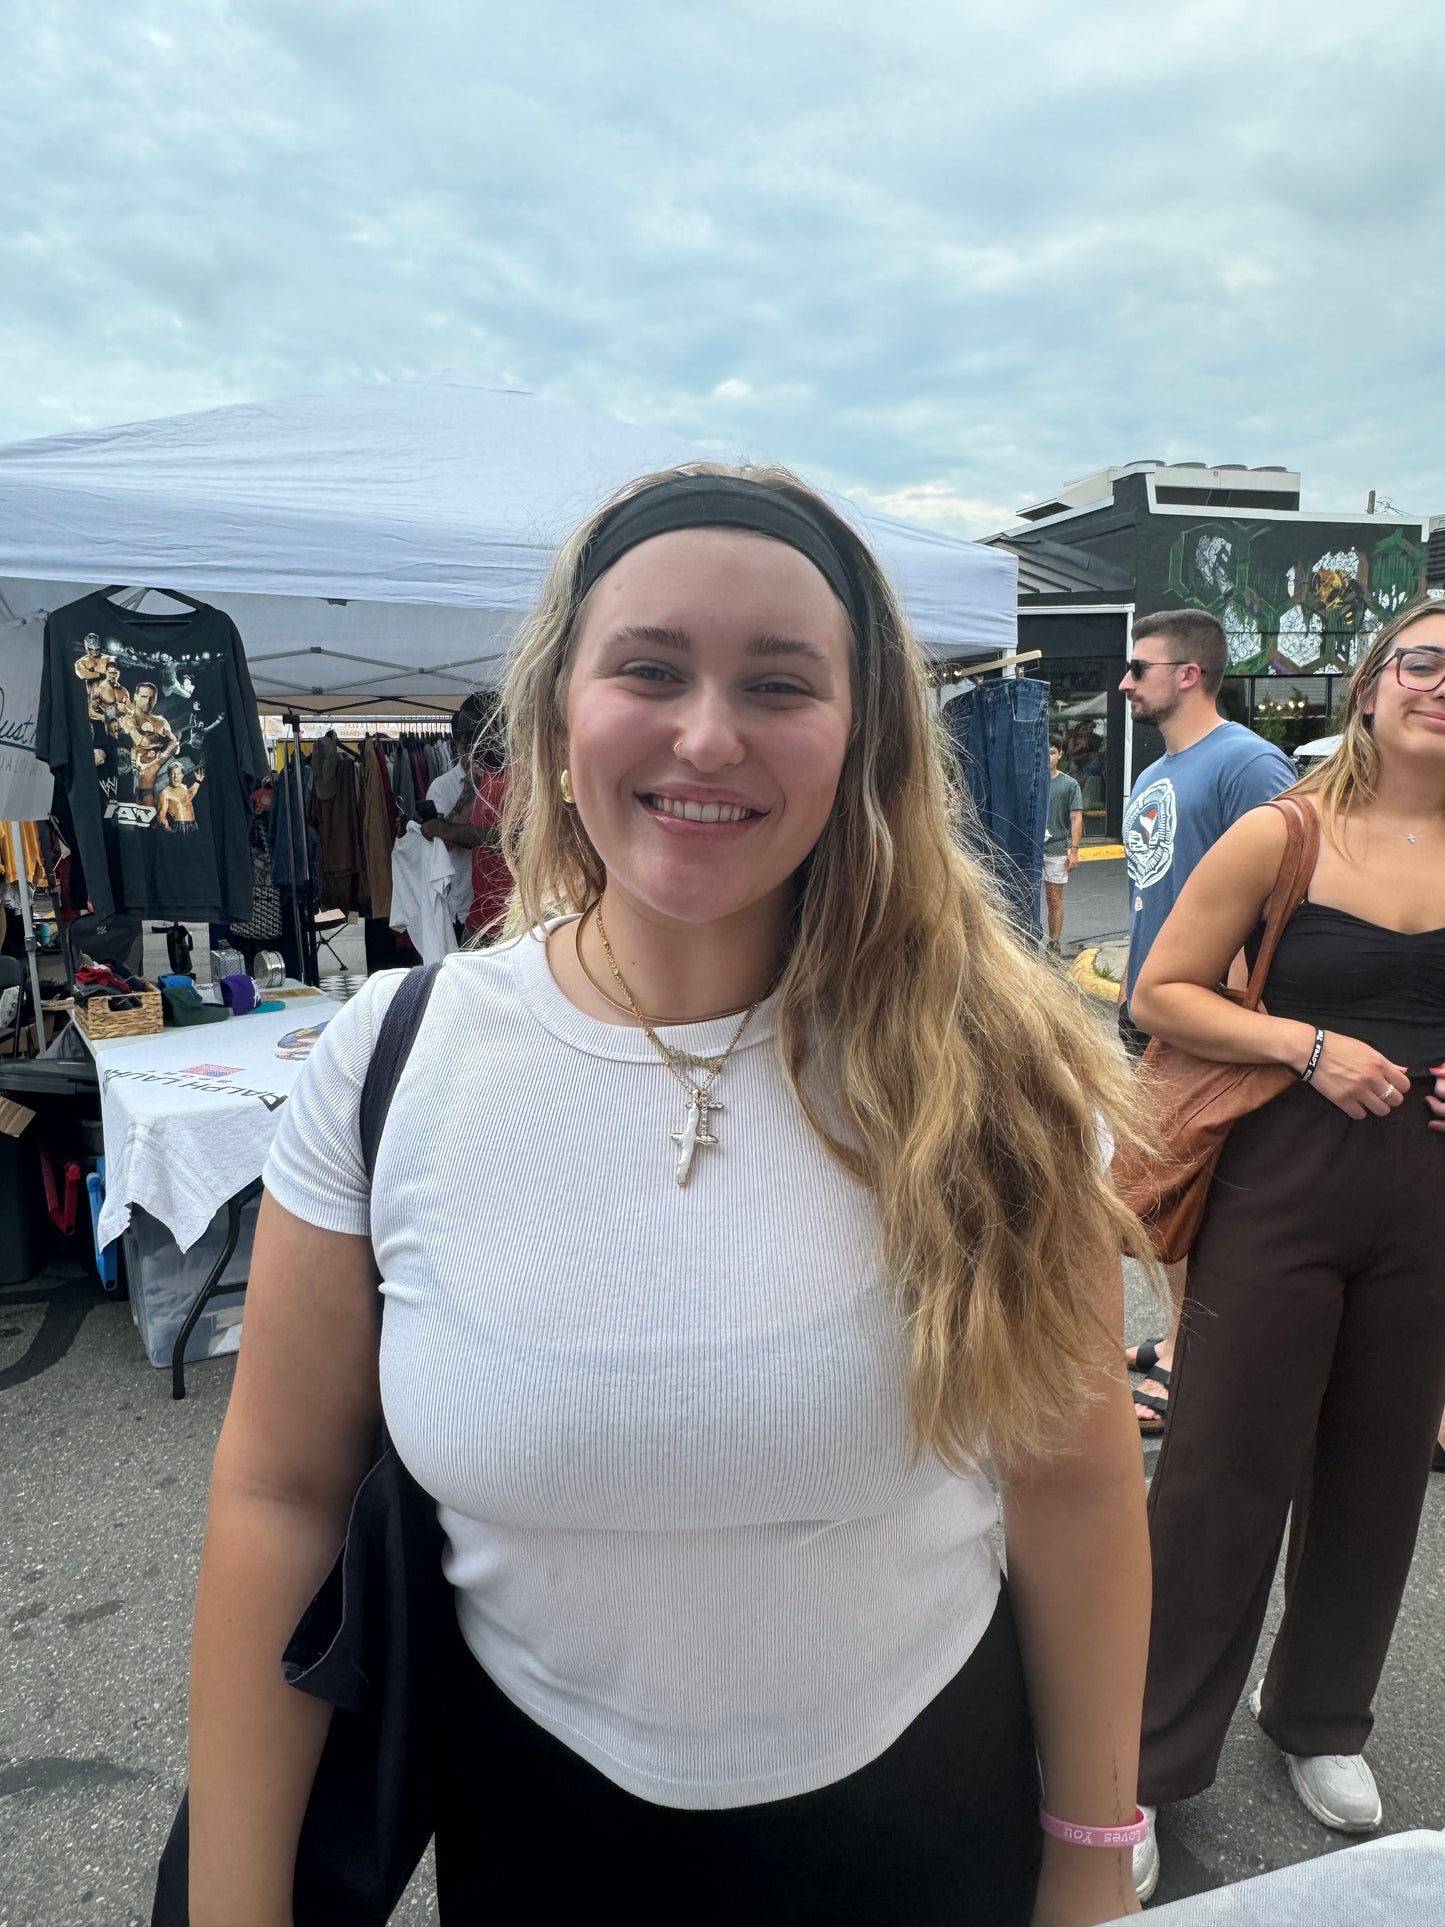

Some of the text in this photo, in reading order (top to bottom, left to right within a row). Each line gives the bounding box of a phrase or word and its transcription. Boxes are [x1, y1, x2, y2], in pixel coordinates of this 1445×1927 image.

[179, 1081, 289, 1113] RALPH
[1063, 1827, 1094, 1845] You
[1103, 1829, 1141, 1843] Loves
